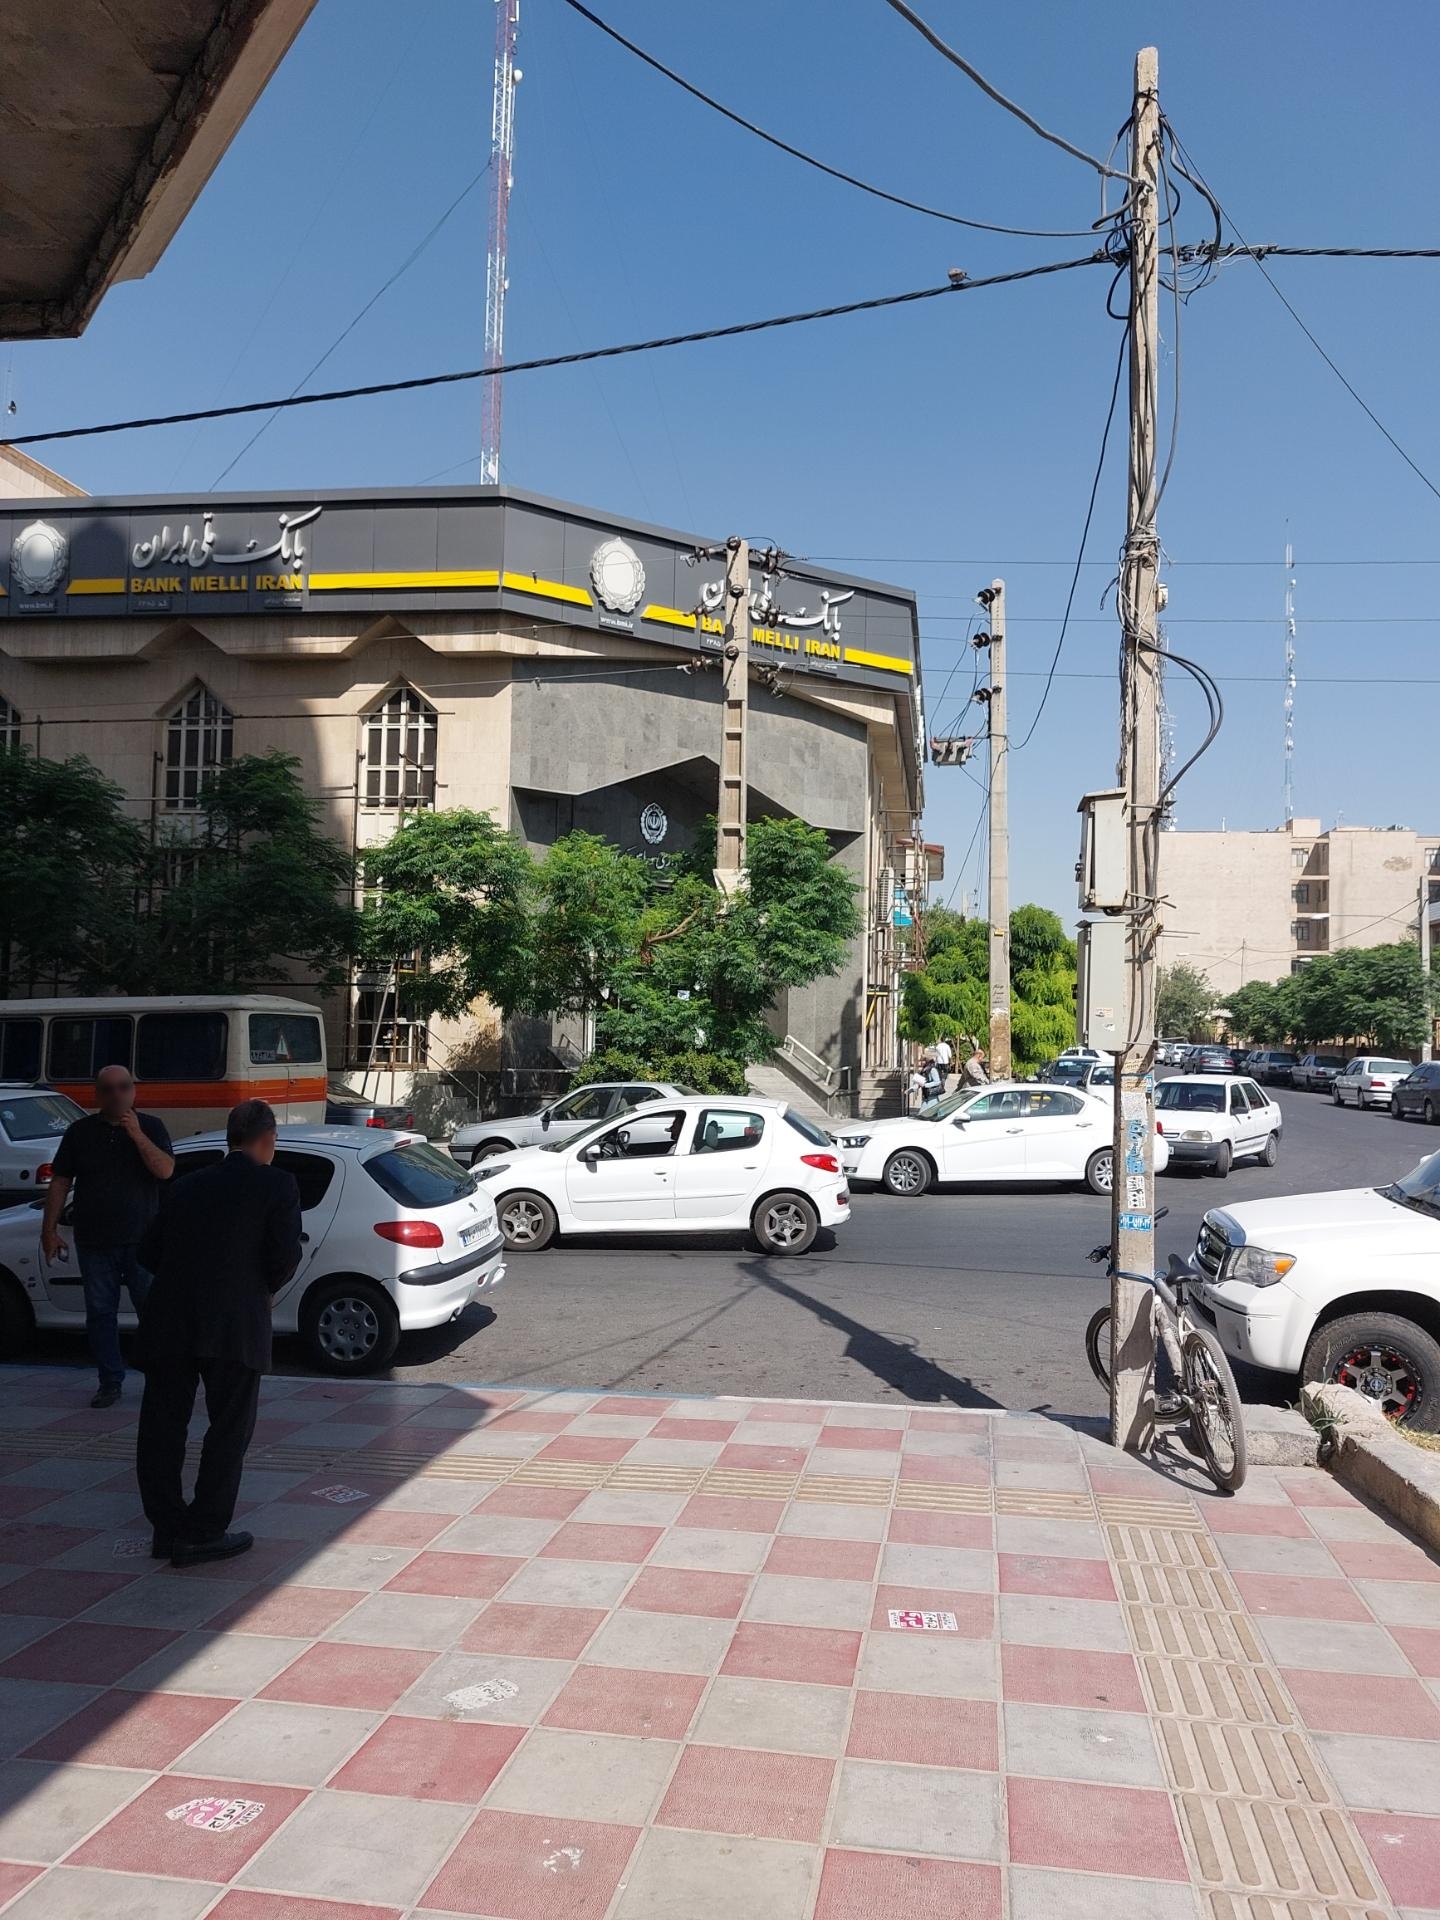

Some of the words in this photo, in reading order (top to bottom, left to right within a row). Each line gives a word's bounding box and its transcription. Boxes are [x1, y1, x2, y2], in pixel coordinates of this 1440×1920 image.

[132, 524, 190, 568] ایران
[213, 505, 323, 569] بانک
[131, 576, 183, 593] BANK
[190, 575, 248, 591] MELLI
[255, 574, 303, 590] IRAN
[701, 615, 724, 635] BA
[752, 627, 799, 650] MELLI
[805, 638, 841, 659] IRAN
[777, 591, 855, 641] بانک
